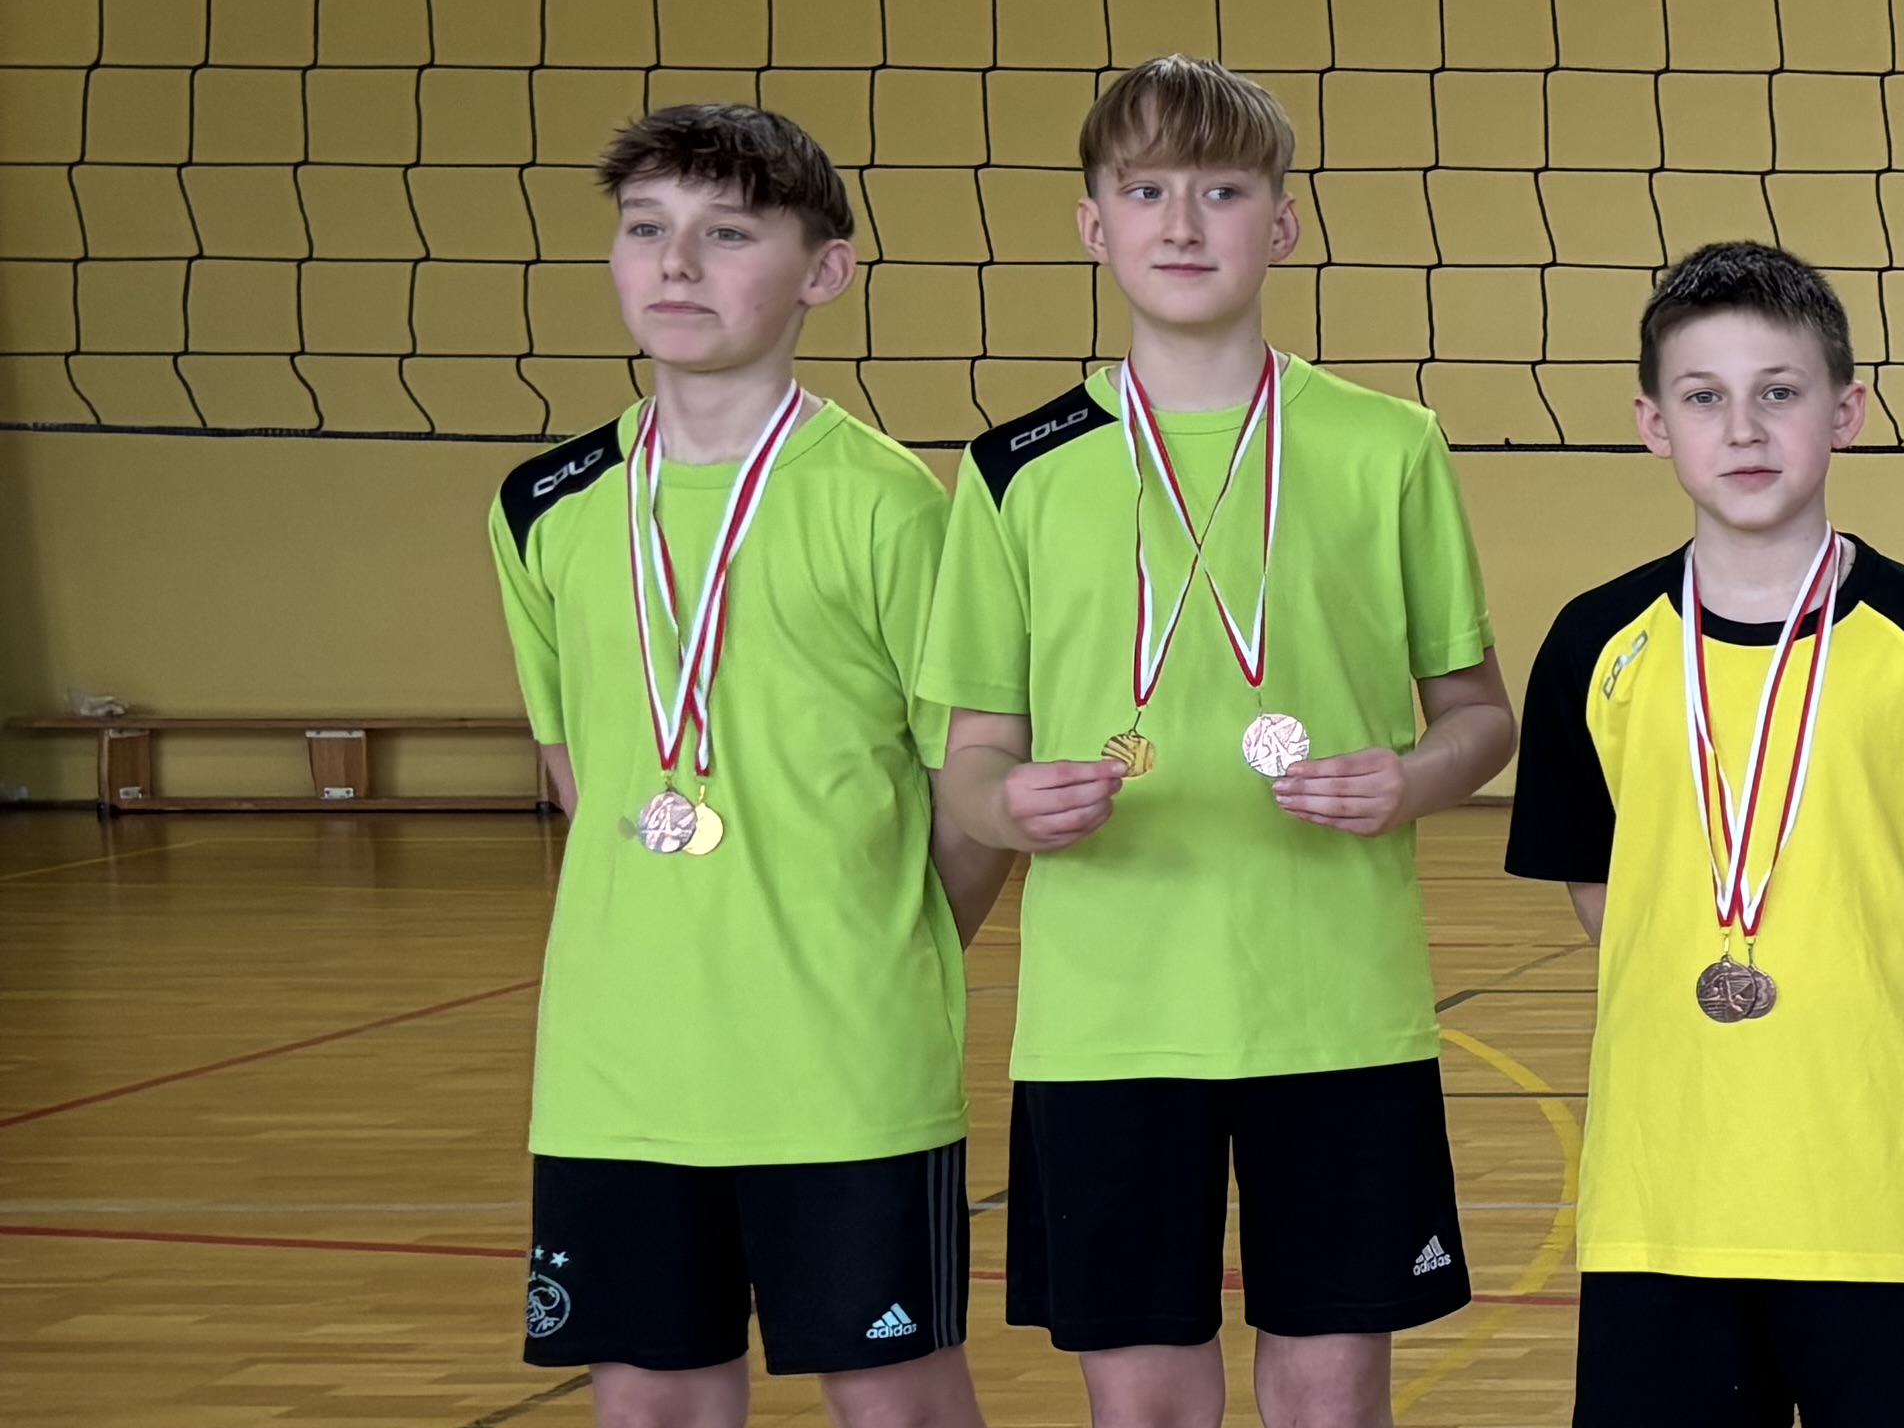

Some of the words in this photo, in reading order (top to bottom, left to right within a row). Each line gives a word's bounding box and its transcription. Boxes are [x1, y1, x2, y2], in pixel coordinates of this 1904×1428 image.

[1010, 408, 1088, 452] COLO
[533, 448, 604, 498] COLO
[1413, 1254, 1451, 1276] adidas
[866, 1323, 917, 1339] adidas
